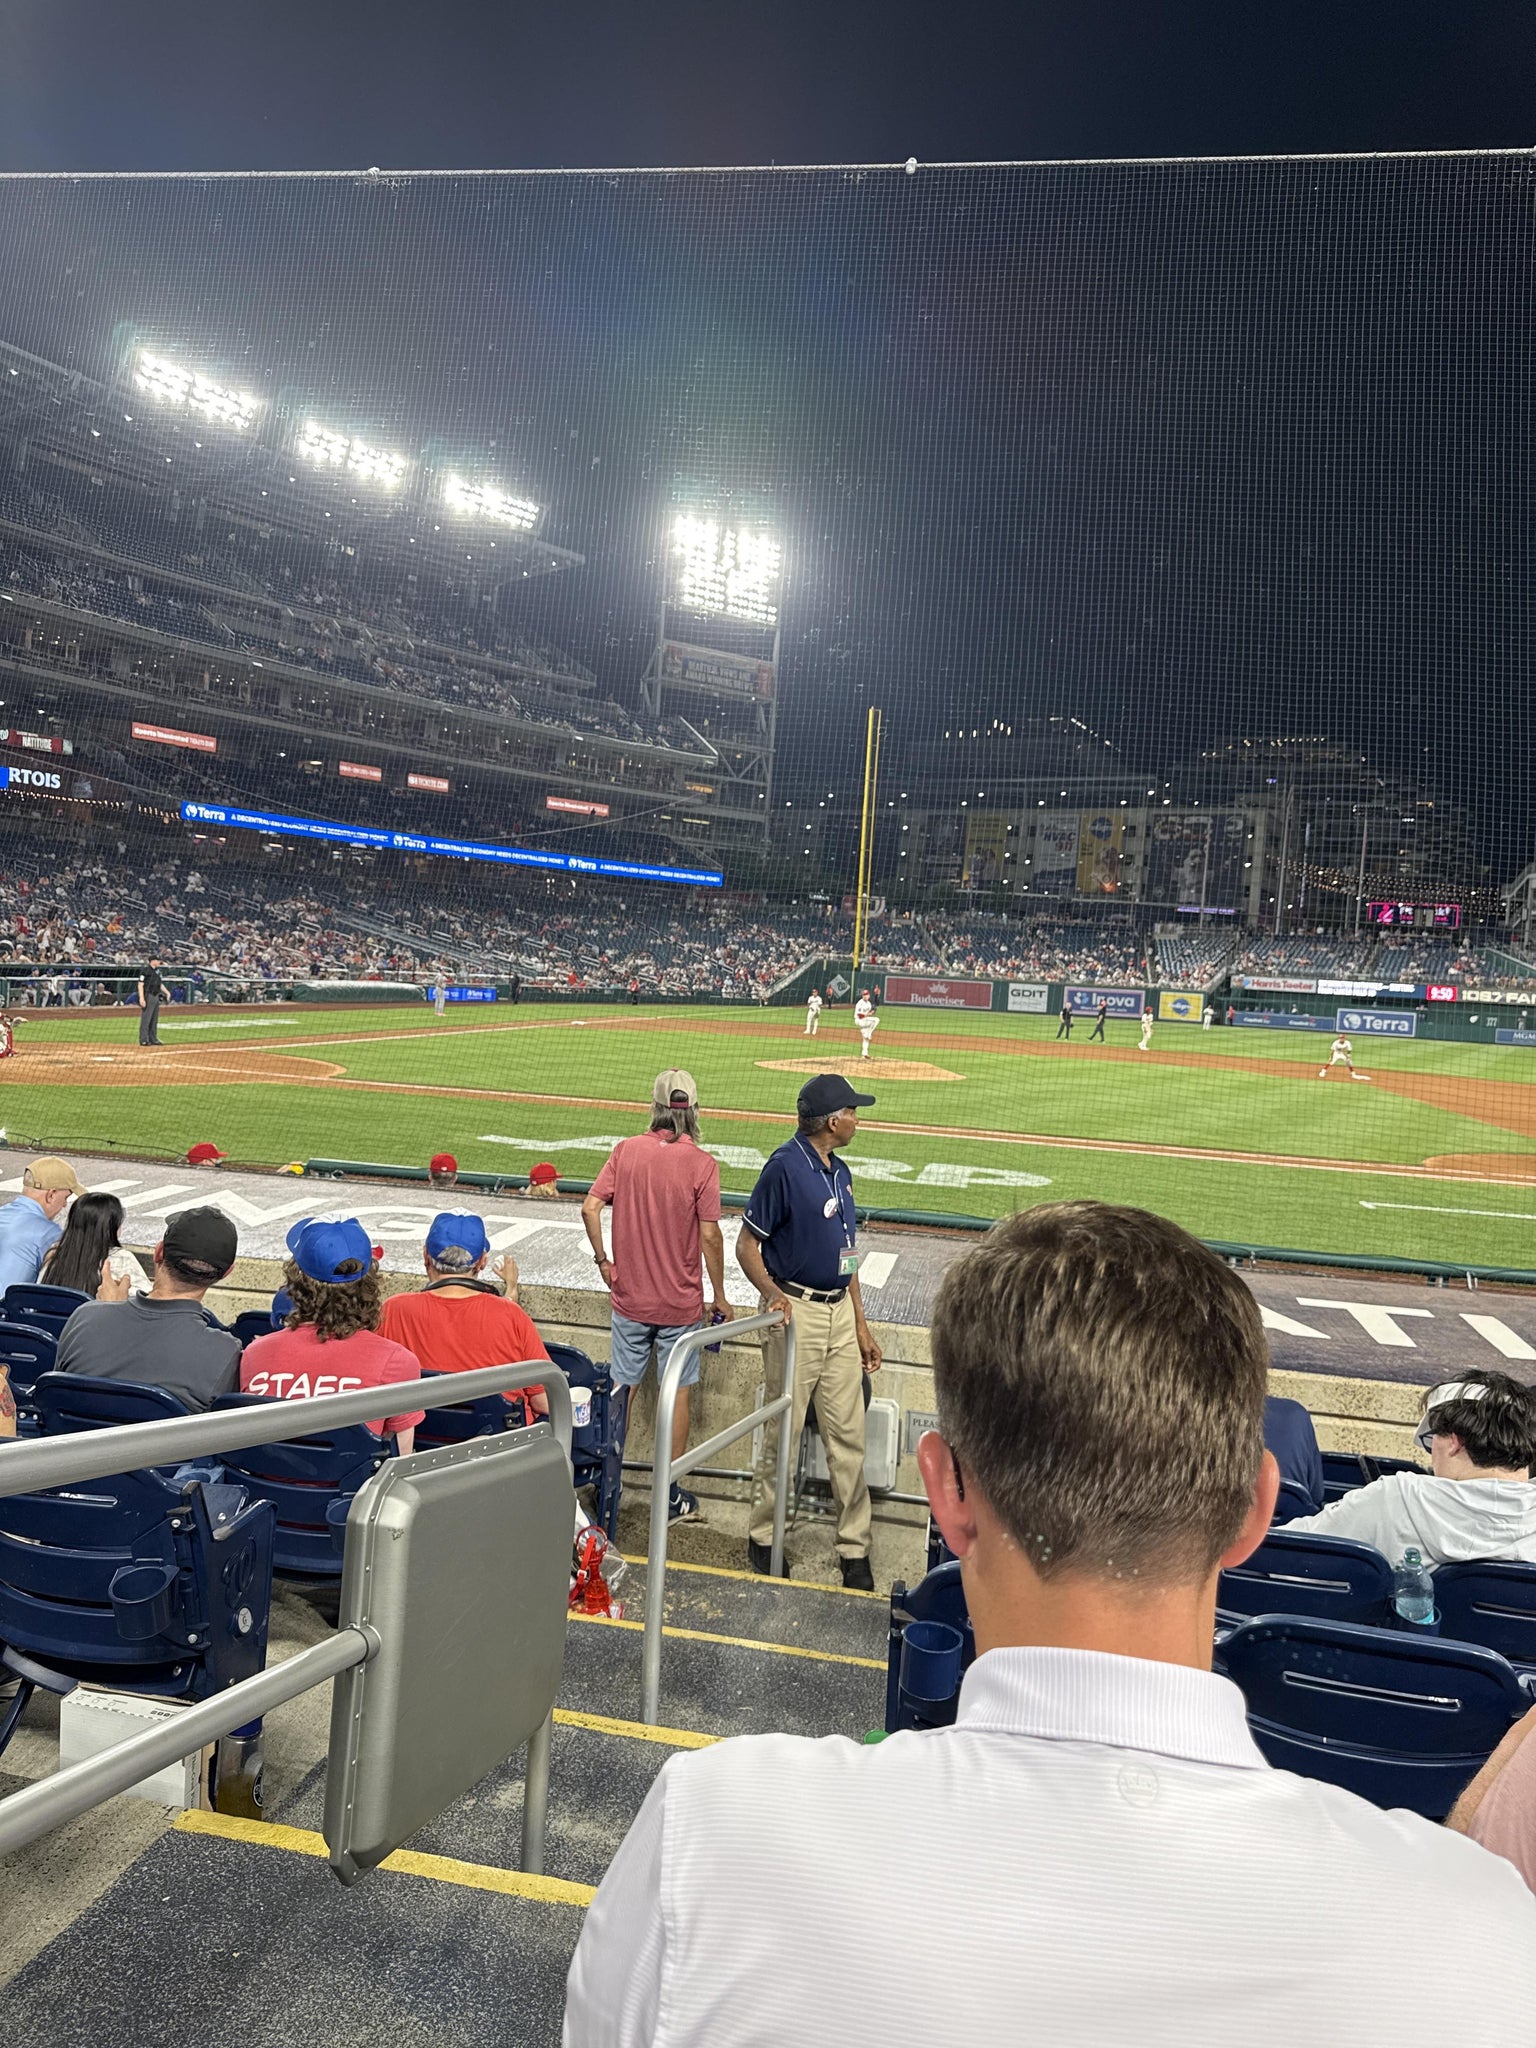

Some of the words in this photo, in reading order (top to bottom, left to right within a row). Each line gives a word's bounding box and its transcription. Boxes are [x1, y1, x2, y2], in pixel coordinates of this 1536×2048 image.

[197, 806, 226, 821] Terra
[403, 836, 427, 849] Terra
[577, 859, 597, 870] Terra
[1252, 979, 1281, 990] Harris
[1282, 980, 1314, 991] Teeter
[910, 993, 966, 1007] Budweiser
[1010, 989, 1046, 998] GDIT
[1362, 1015, 1410, 1033] Terra
[249, 1371, 362, 1400] STAFF
